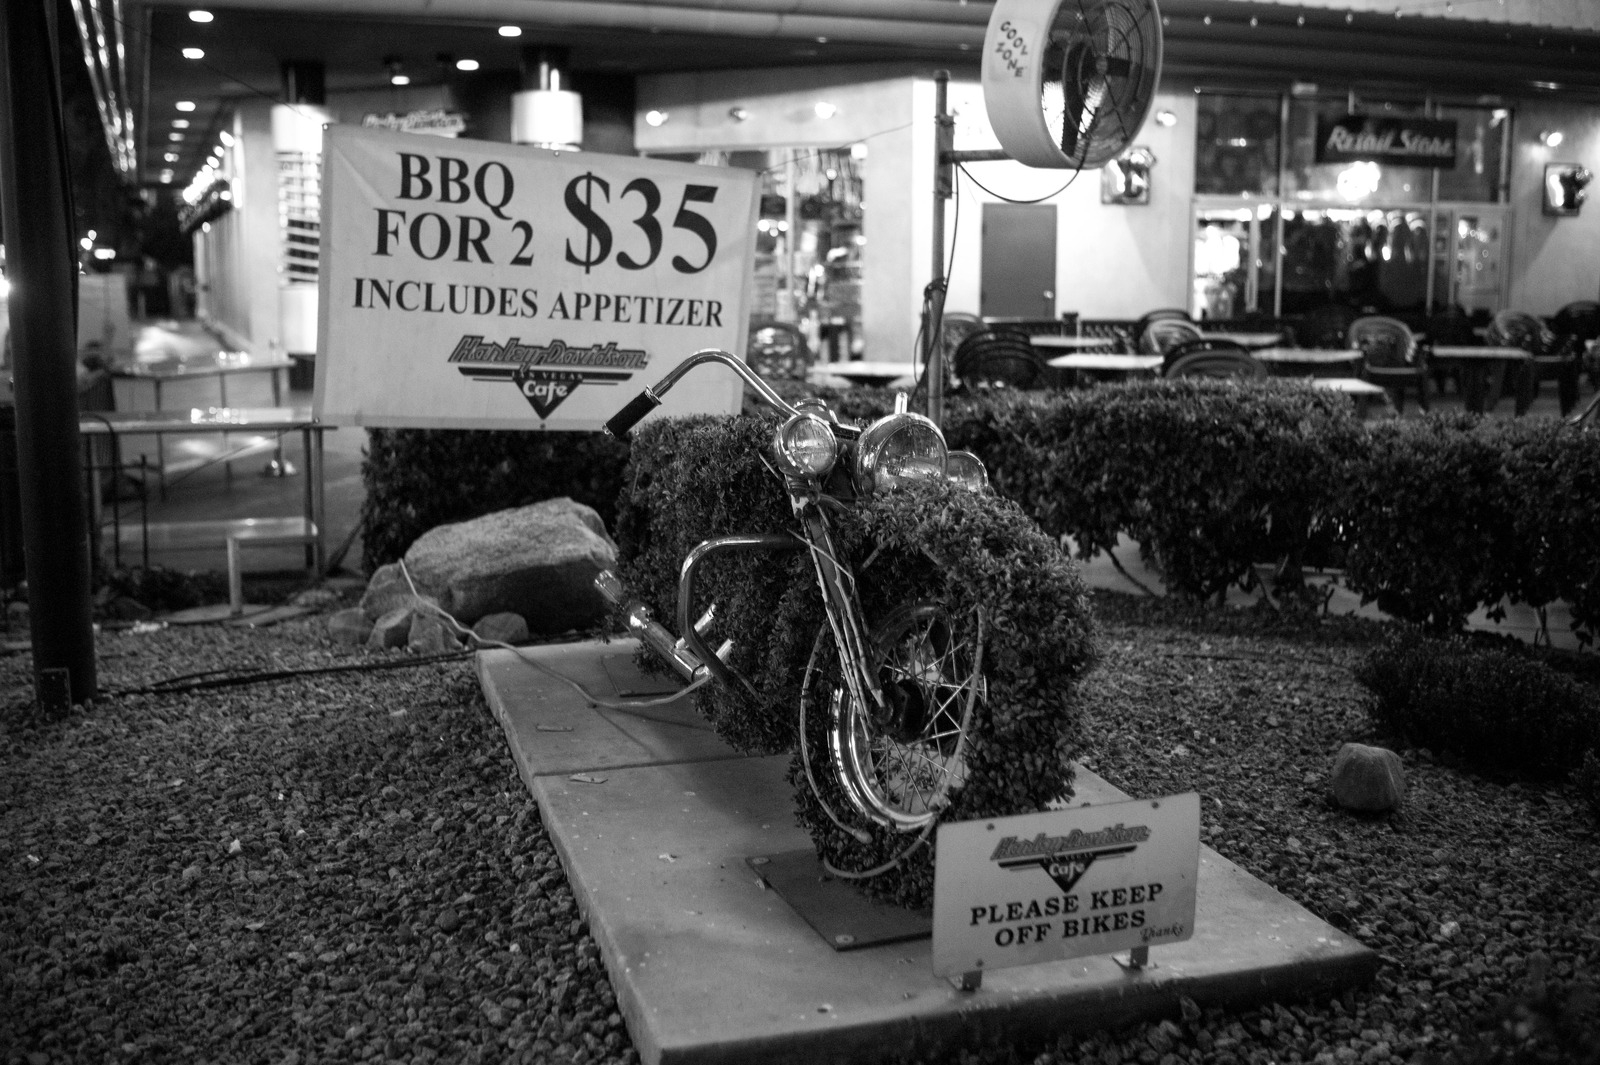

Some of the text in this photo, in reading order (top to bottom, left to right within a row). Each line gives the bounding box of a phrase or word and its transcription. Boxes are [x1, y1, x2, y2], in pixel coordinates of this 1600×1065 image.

[1000, 21, 1028, 55] COOL
[995, 42, 1024, 77] ZONE
[395, 152, 515, 220] BBQ
[372, 208, 535, 266] FOR 2
[564, 172, 719, 275] $35
[352, 277, 724, 328] INCLUDES APPETIZER
[522, 380, 568, 406] Cafe
[542, 371, 583, 380] VEGAS
[970, 882, 1164, 926] PLEASE KEEP
[995, 910, 1146, 948] OFF BIKES
[1140, 922, 1185, 939] Thanks
